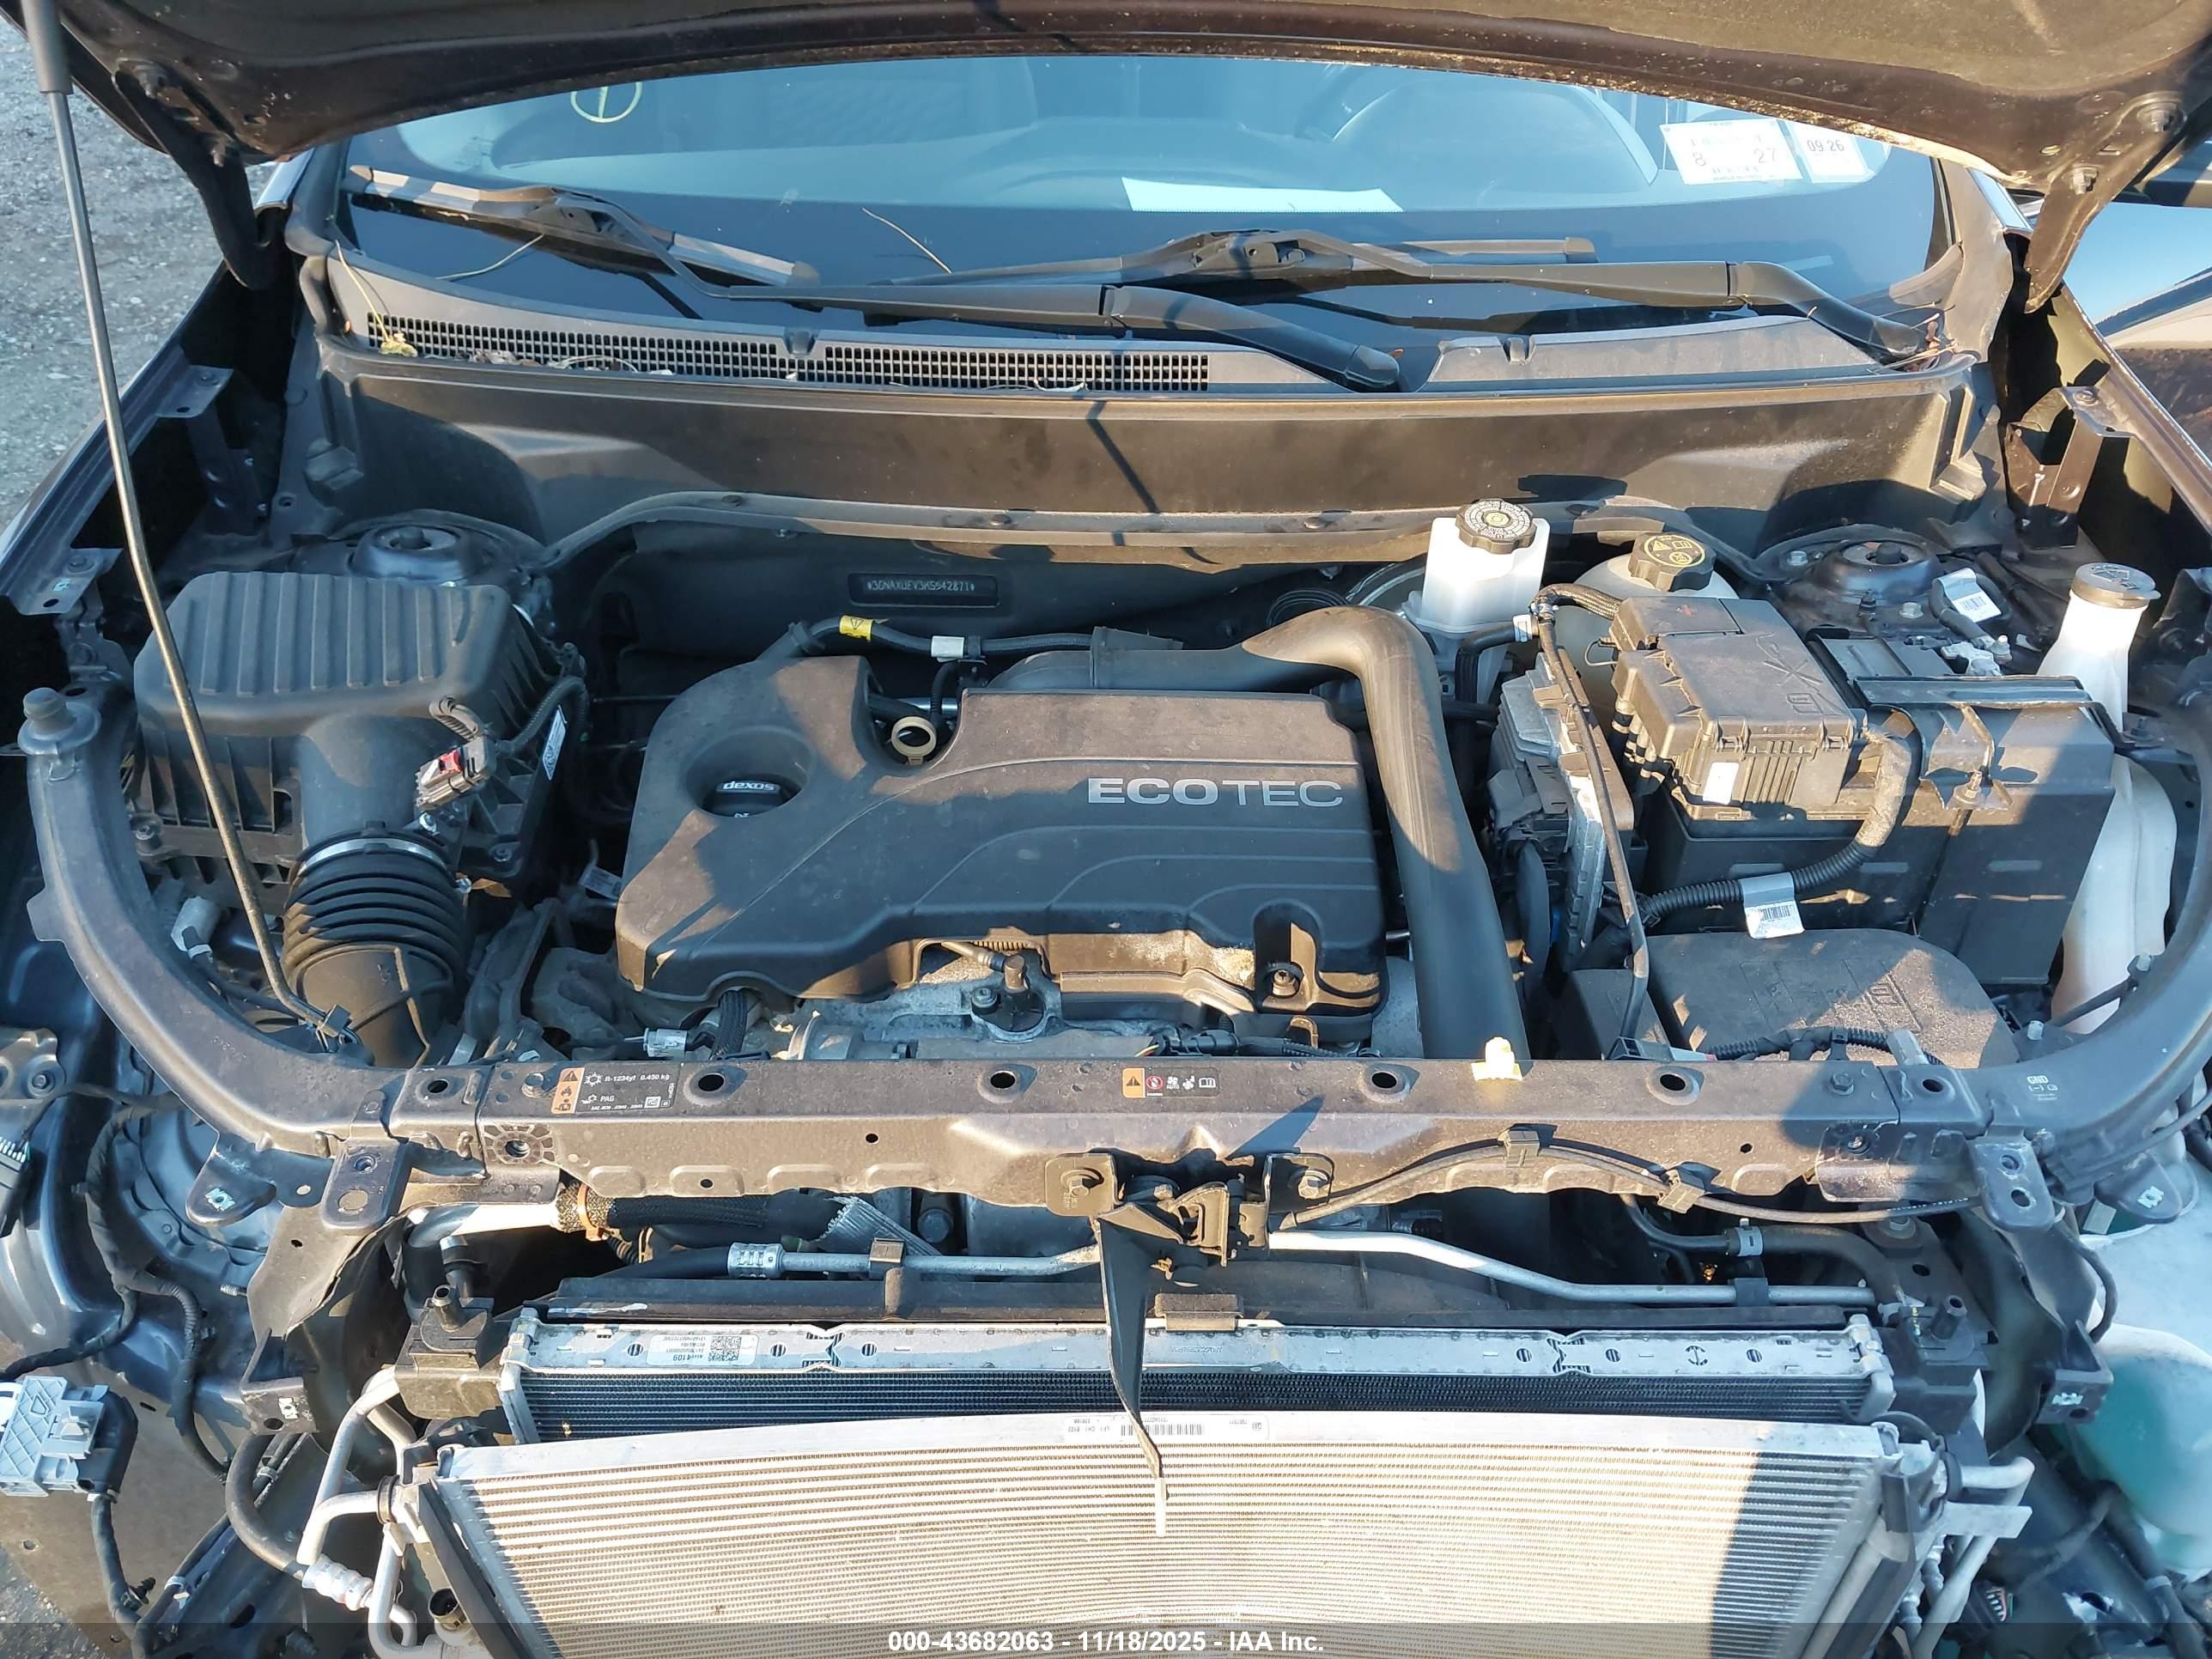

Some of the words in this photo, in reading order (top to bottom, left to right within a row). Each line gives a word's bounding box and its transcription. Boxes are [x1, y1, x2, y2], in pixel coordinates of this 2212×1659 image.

[1692, 151, 1707, 167] 8
[1753, 146, 1778, 164] 27
[722, 781, 775, 791] dexos
[1087, 778, 1344, 807] ECOTEC
